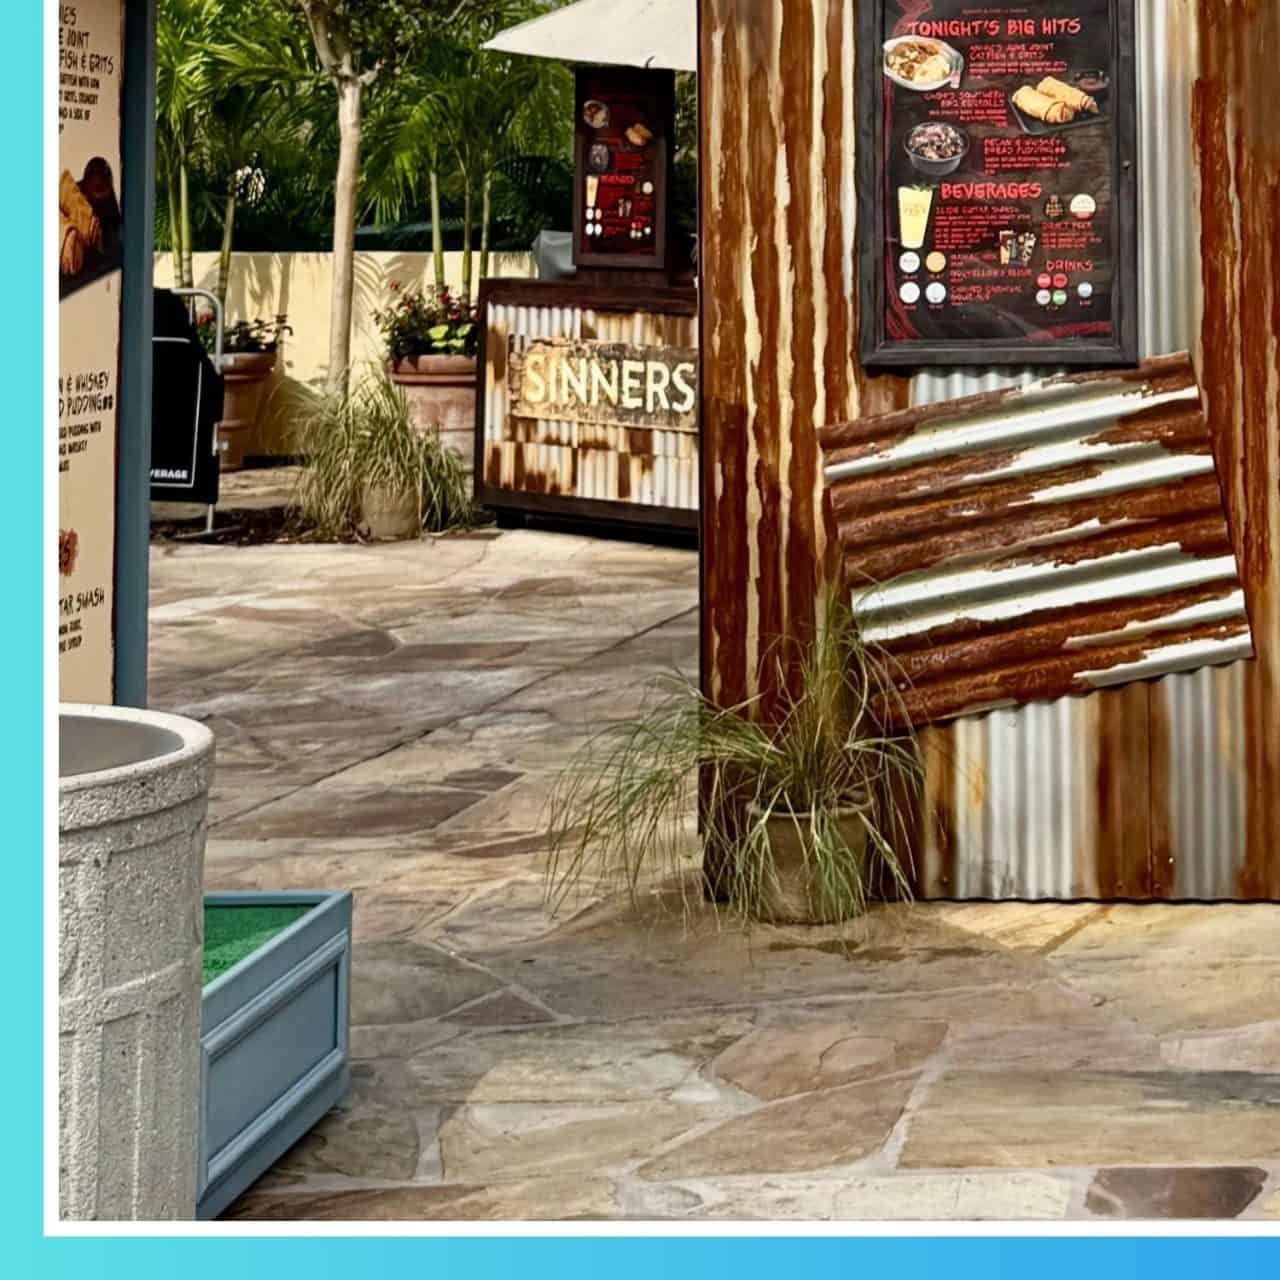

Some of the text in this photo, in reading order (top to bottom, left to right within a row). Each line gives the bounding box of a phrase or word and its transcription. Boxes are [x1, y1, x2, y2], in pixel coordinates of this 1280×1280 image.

[909, 17, 1081, 37] TONIGHT'S BIG HITS
[66, 28, 90, 49] JOINT
[89, 53, 114, 75] GRITS
[940, 183, 1042, 200] BEVERAGES
[1046, 260, 1093, 273] DRINKS
[75, 371, 109, 393] WHISKEY
[524, 352, 696, 414] SINNERS
[67, 393, 101, 417] PUDDING
[76, 587, 104, 612] SMASH
